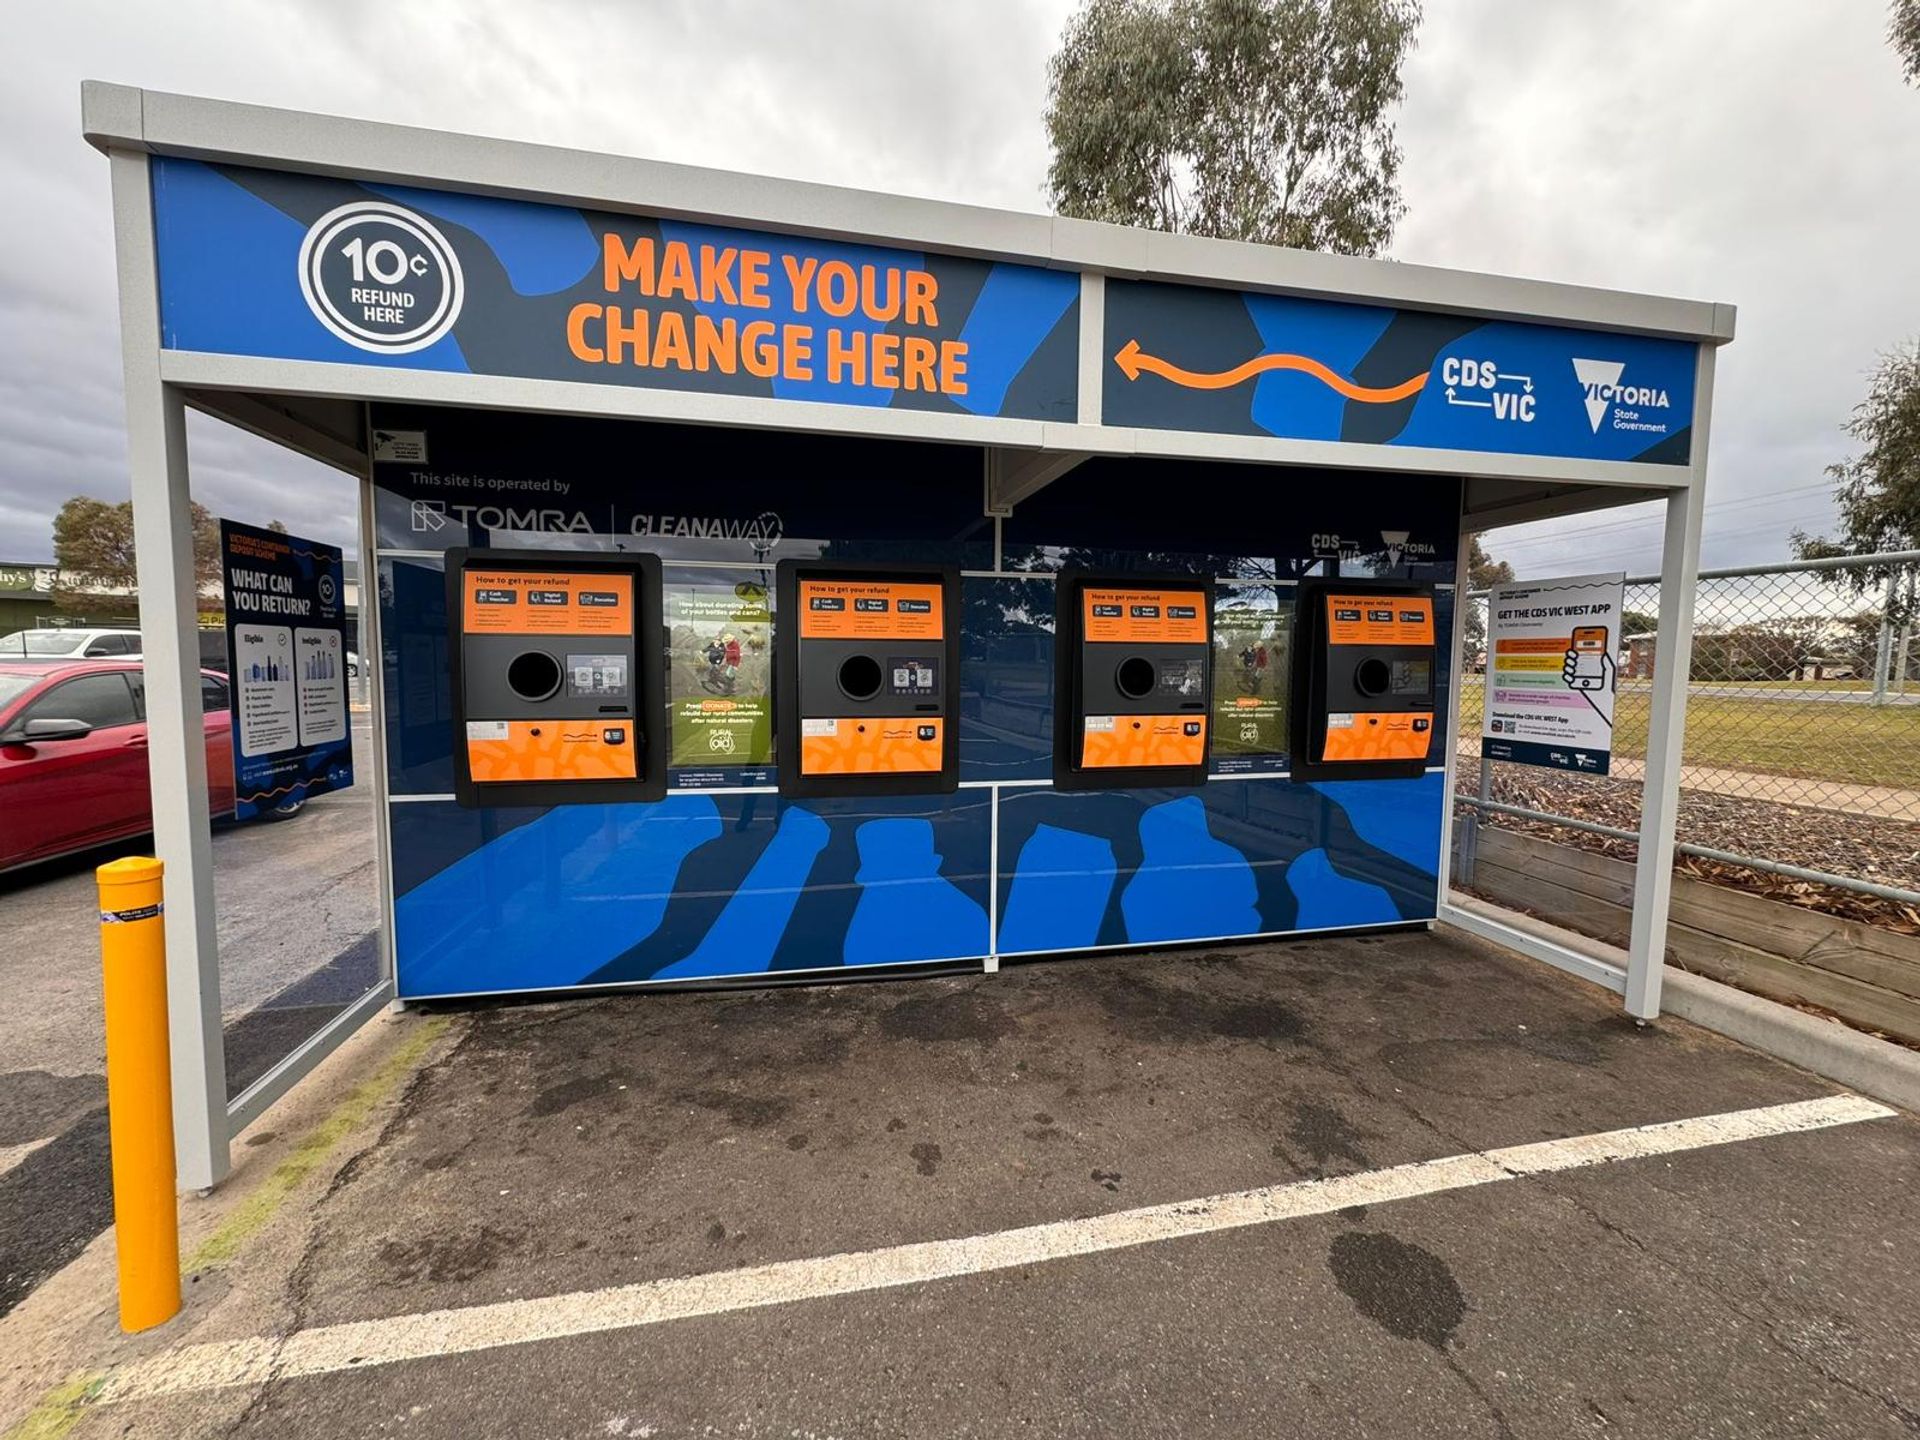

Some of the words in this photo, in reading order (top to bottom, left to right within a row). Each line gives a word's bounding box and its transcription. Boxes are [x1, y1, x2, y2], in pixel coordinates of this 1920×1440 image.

[602, 232, 771, 309] MAKE
[782, 254, 939, 328] YOUR
[351, 287, 415, 309] REFUND
[363, 305, 404, 325] HERE
[566, 302, 814, 381] CHANGE
[827, 328, 969, 396] HERE
[1442, 357, 1497, 390] CDS
[1492, 391, 1536, 422] VIC
[1583, 382, 1670, 408] VICTORIA
[1613, 418, 1667, 433] Government
[1614, 408, 1639, 421] State
[410, 472, 441, 486] This
[444, 473, 470, 487] site
[473, 475, 485, 488] is
[487, 477, 551, 492] operated
[553, 479, 571, 495] by
[452, 505, 594, 533] TOMRA
[630, 514, 775, 541] CLEANAWAY
[1311, 534, 1340, 549] CDS
[231, 568, 268, 589] WHAT
[270, 575, 293, 594] CAN
[476, 576, 495, 584] How
[508, 578, 521, 586] get
[543, 577, 570, 585] refund
[232, 591, 260, 611] YOU
[262, 595, 311, 615] RETURN?
[1498, 610, 1512, 619] GET
[1514, 609, 1529, 618] THE
[1531, 607, 1547, 617] CDS
[1549, 606, 1563, 617] VIC
[1564, 605, 1590, 615] WEST
[1590, 603, 1611, 614] APP
